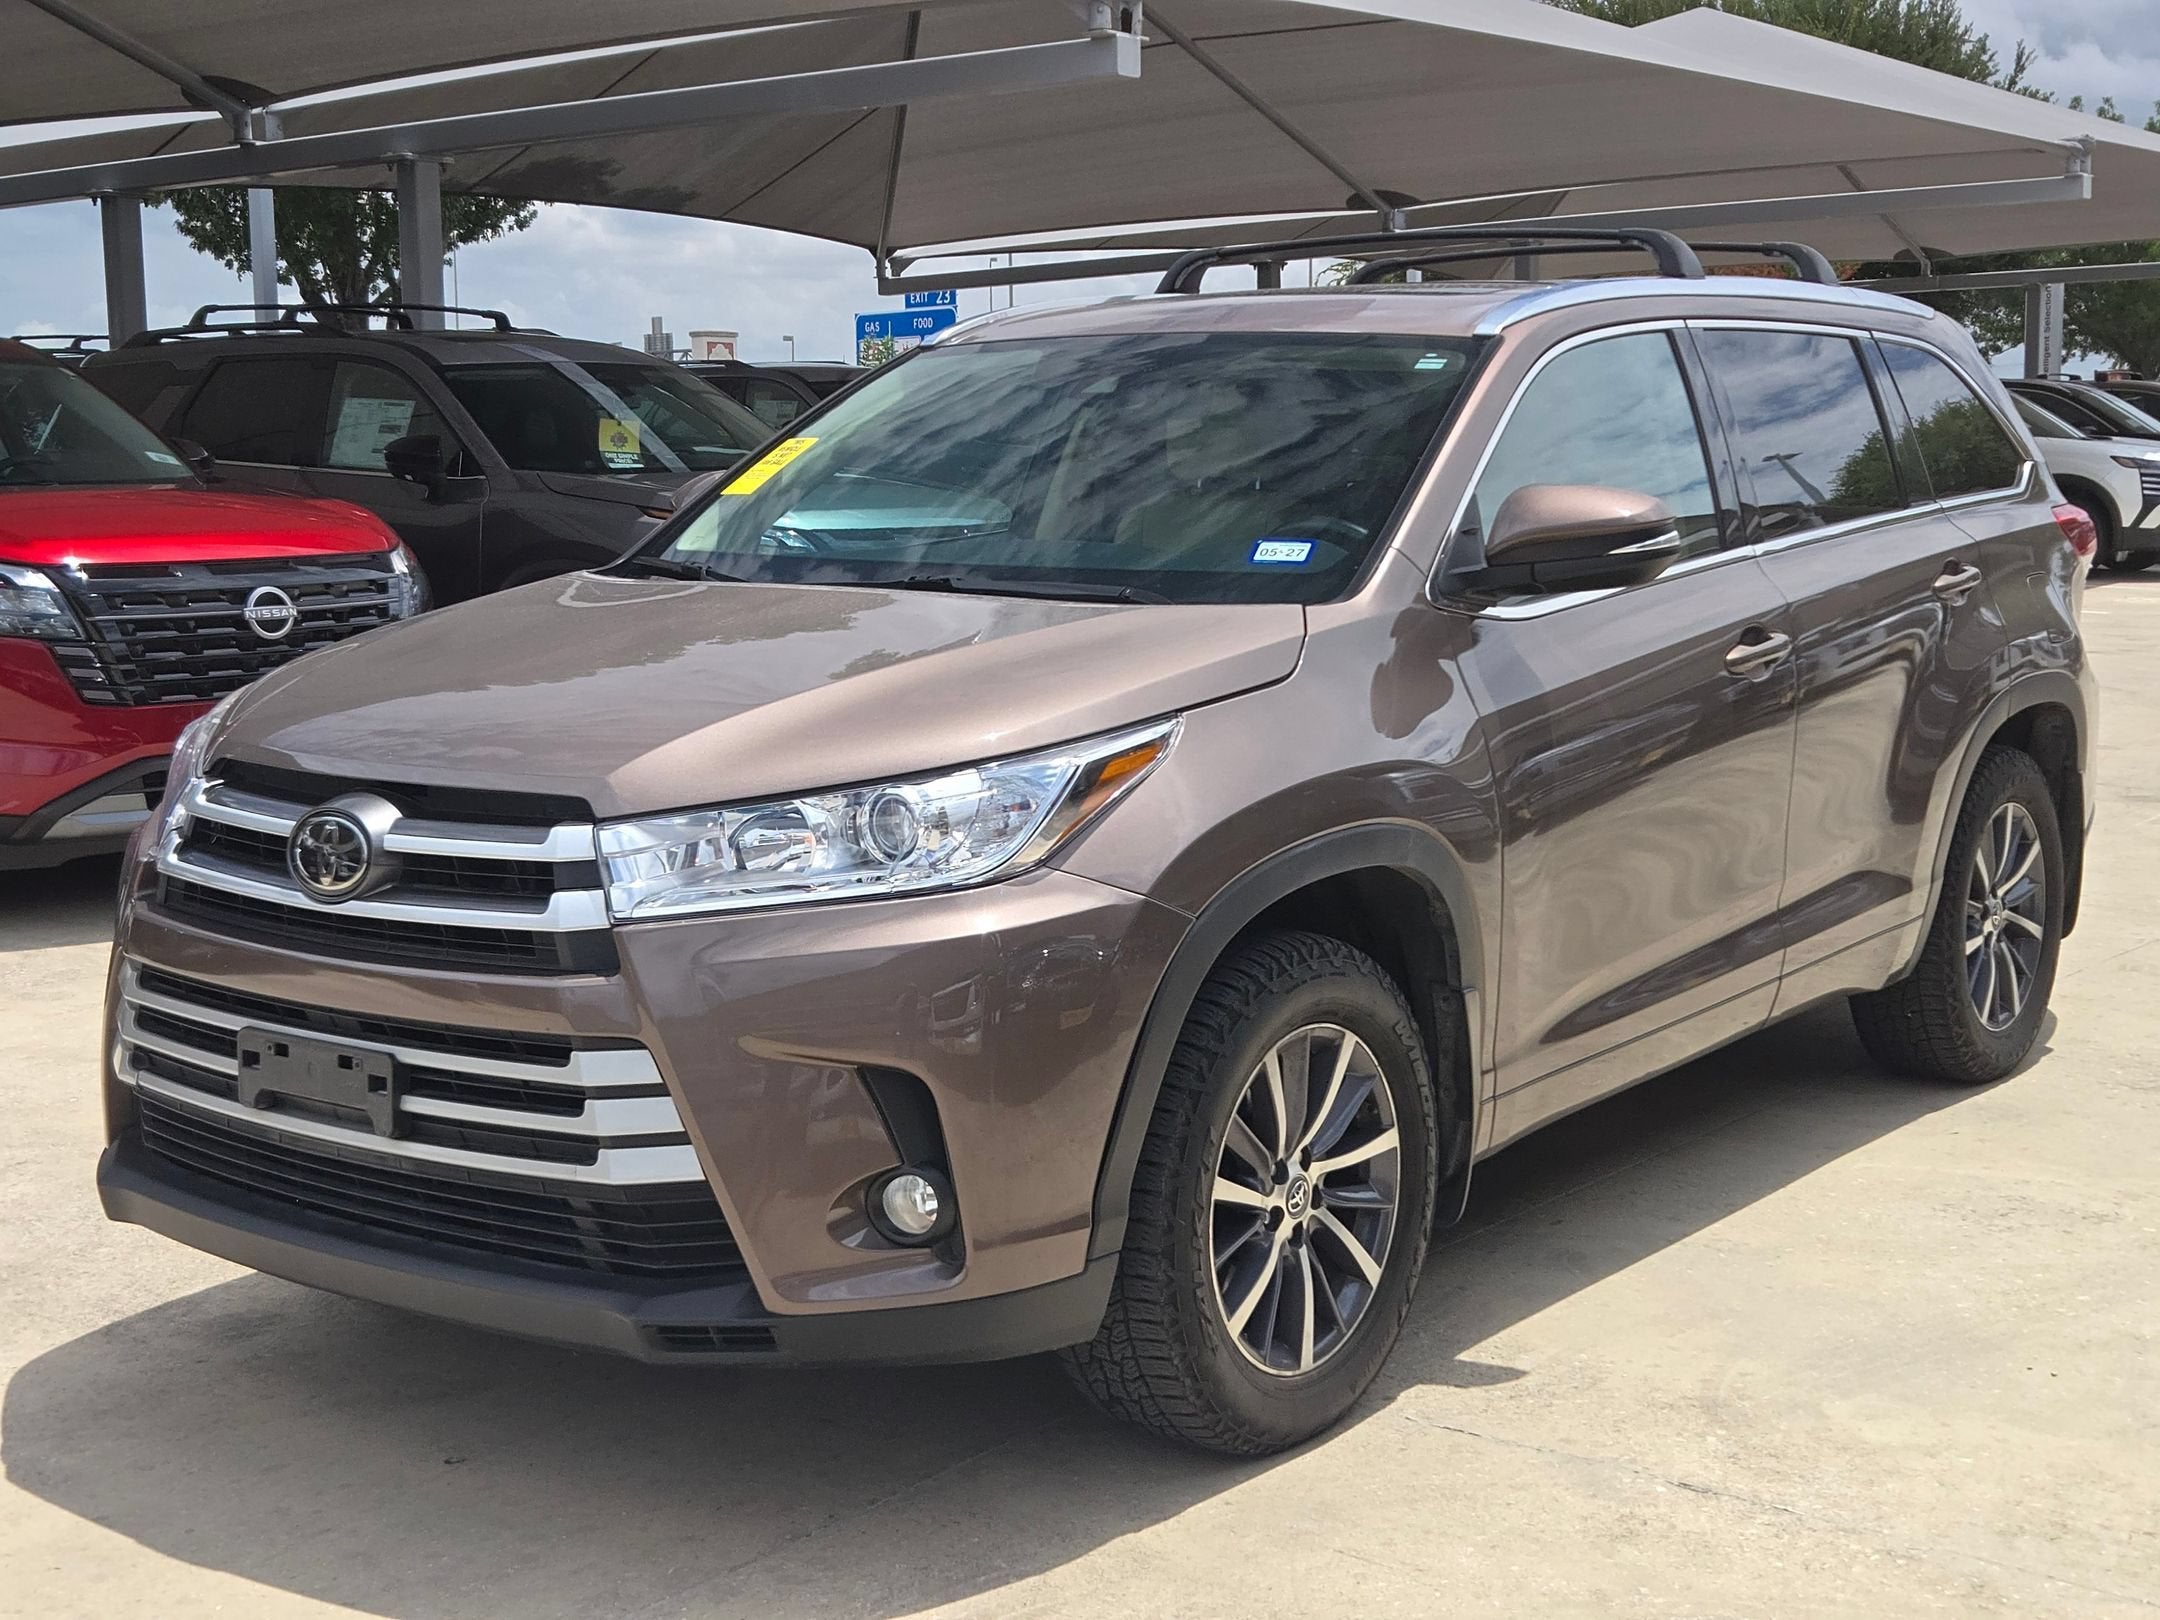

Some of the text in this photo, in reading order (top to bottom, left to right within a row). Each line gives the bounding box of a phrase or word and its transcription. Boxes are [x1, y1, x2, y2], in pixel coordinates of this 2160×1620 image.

[911, 290, 950, 304] EXIT 23
[2043, 285, 2052, 333] Selection
[865, 322, 880, 333] GAS
[913, 317, 933, 329] FOOD
[245, 608, 297, 618] NISSAN
